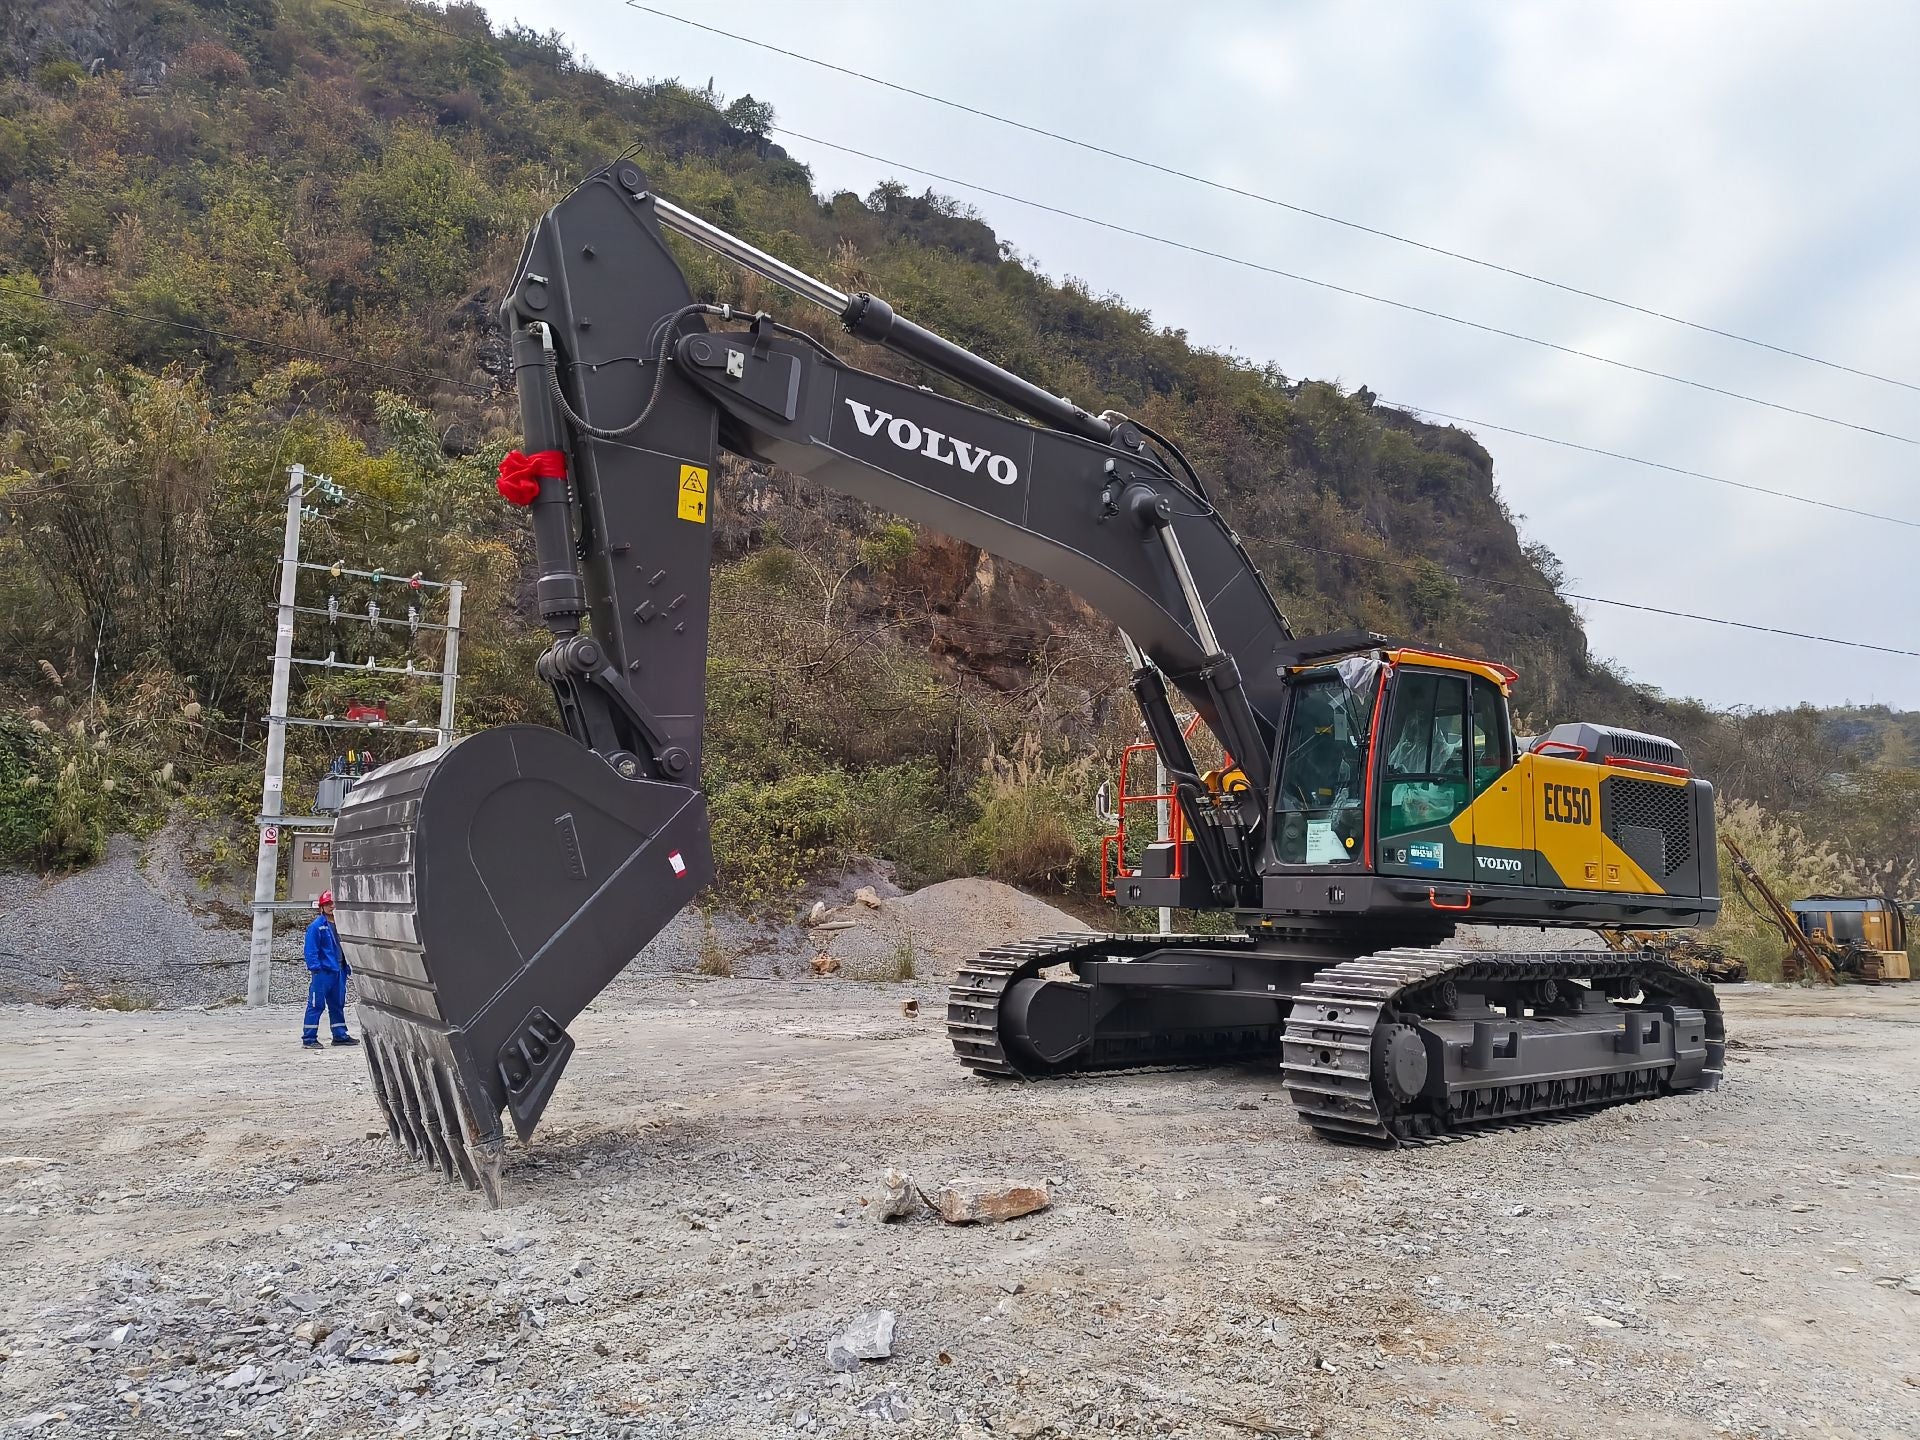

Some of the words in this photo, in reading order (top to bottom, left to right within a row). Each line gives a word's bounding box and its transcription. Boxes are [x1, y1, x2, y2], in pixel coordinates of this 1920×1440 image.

[845, 398, 1018, 485] VOLVO
[1544, 783, 1591, 825] EC550
[1476, 856, 1522, 871] VOLVO
